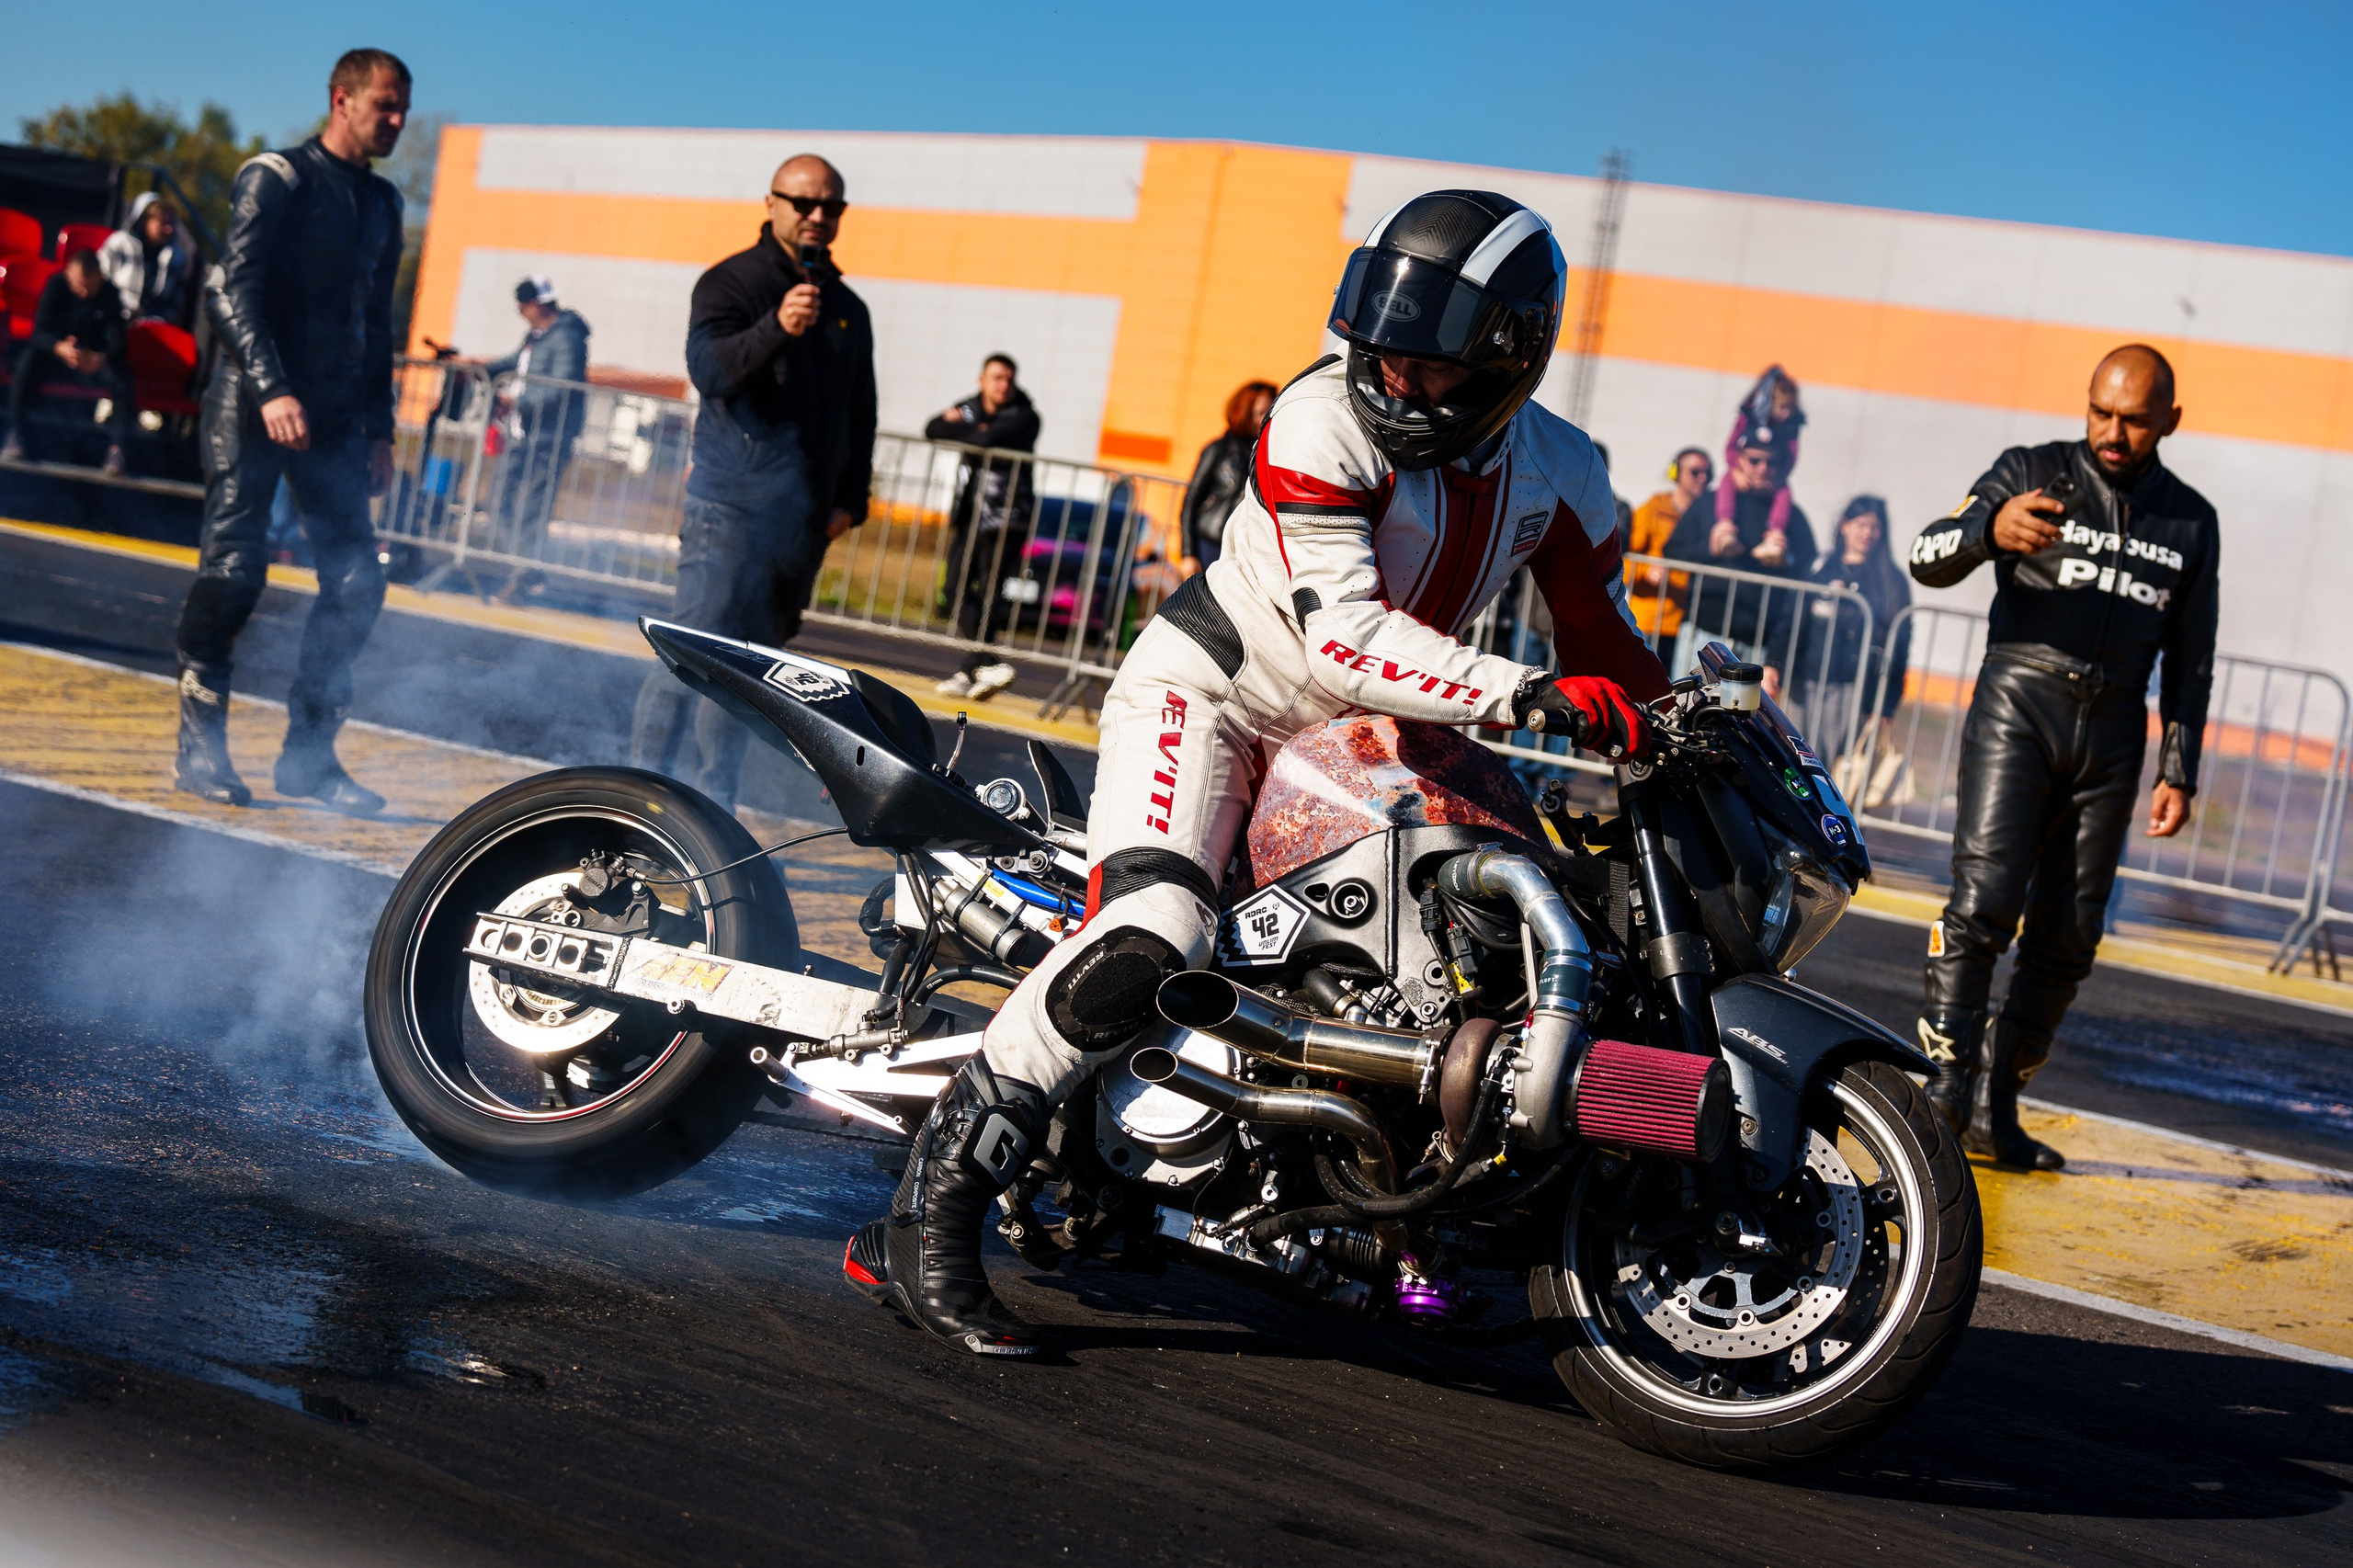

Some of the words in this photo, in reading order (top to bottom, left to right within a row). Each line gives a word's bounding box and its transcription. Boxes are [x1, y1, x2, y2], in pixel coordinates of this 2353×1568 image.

[1378, 296, 1413, 317] BELL
[1910, 528, 1963, 565] RAPID
[2057, 558, 2172, 612] Pilot
[794, 672, 820, 686] 42
[1320, 639, 1483, 706] REV'IT!
[1245, 906, 1267, 919] RDRC
[1251, 913, 1280, 938] 42
[1262, 942, 1277, 950] FEST
[1727, 1026, 1787, 1058] ABS
[915, 1157, 925, 1177] CARBON
[911, 1181, 920, 1209] COMPOSITE
